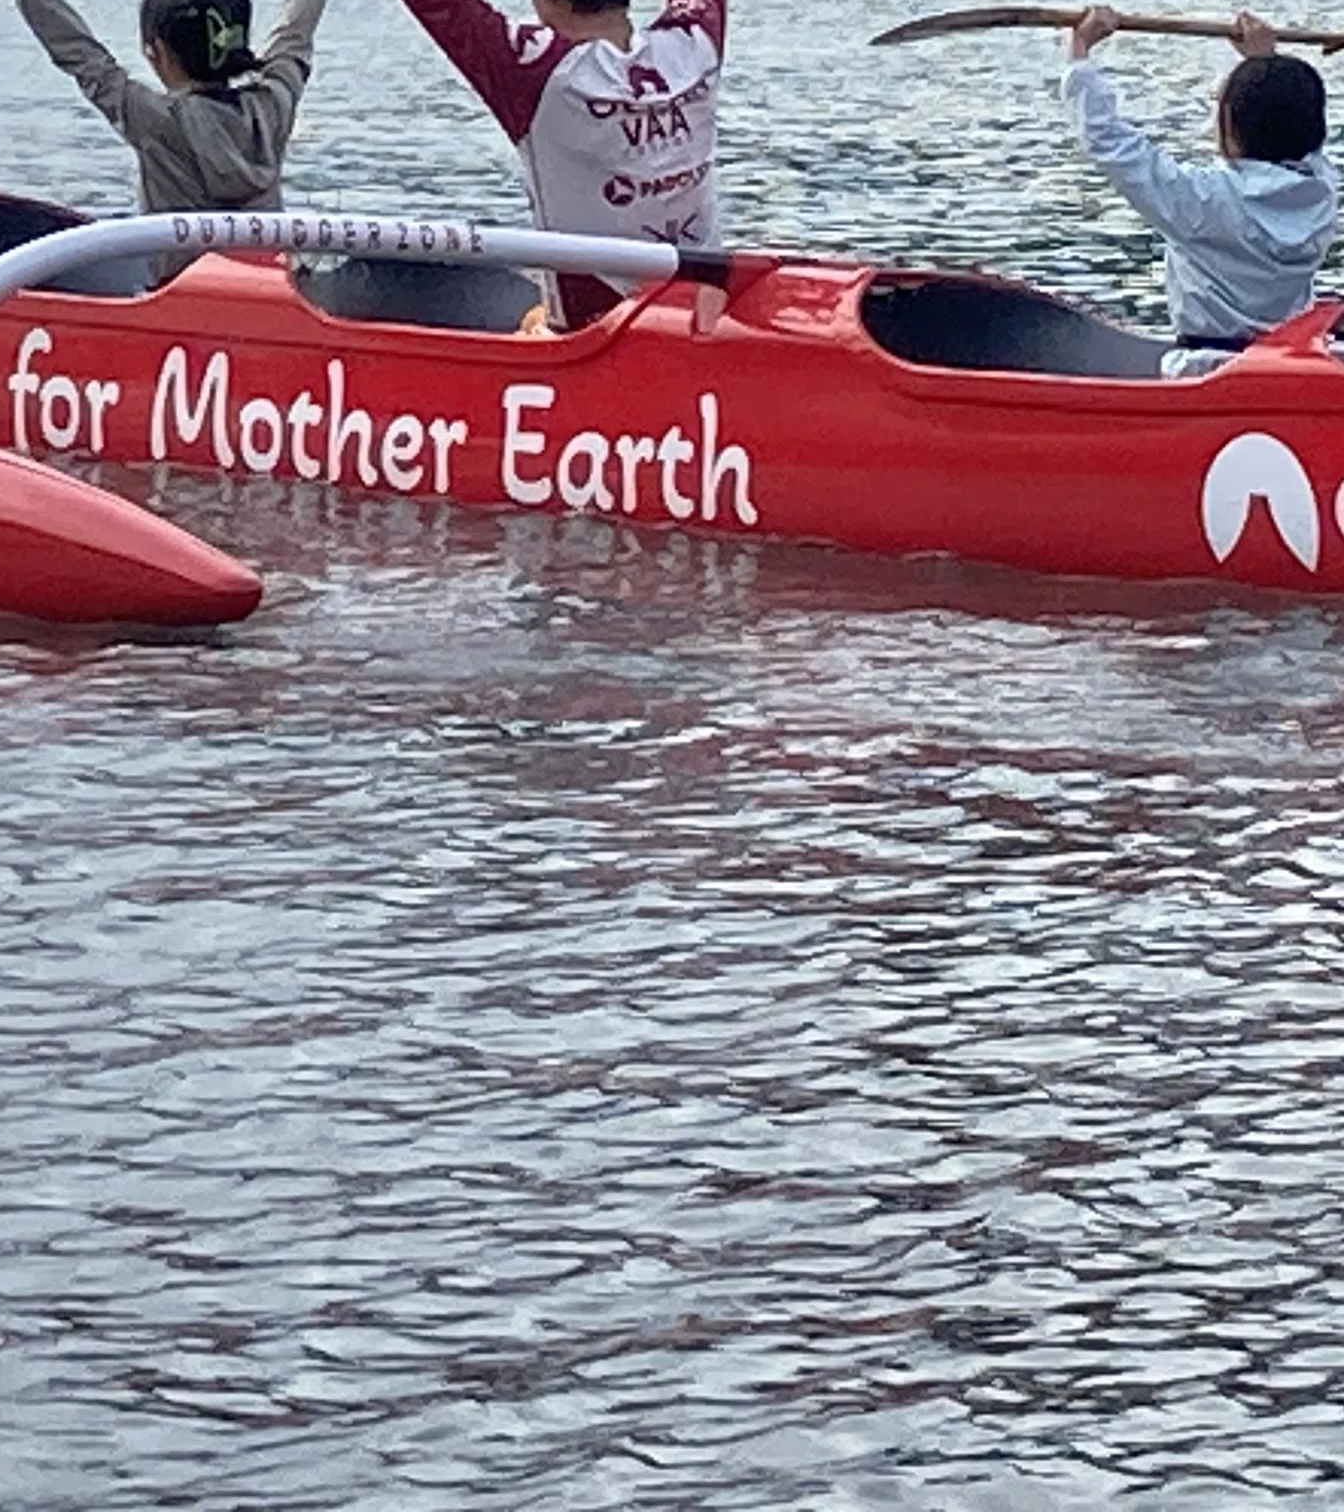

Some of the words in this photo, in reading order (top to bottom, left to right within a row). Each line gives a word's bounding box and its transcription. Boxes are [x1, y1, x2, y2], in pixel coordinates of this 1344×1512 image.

[8, 327, 120, 454] for
[150, 345, 467, 495] Mother
[501, 384, 758, 525] Earth
